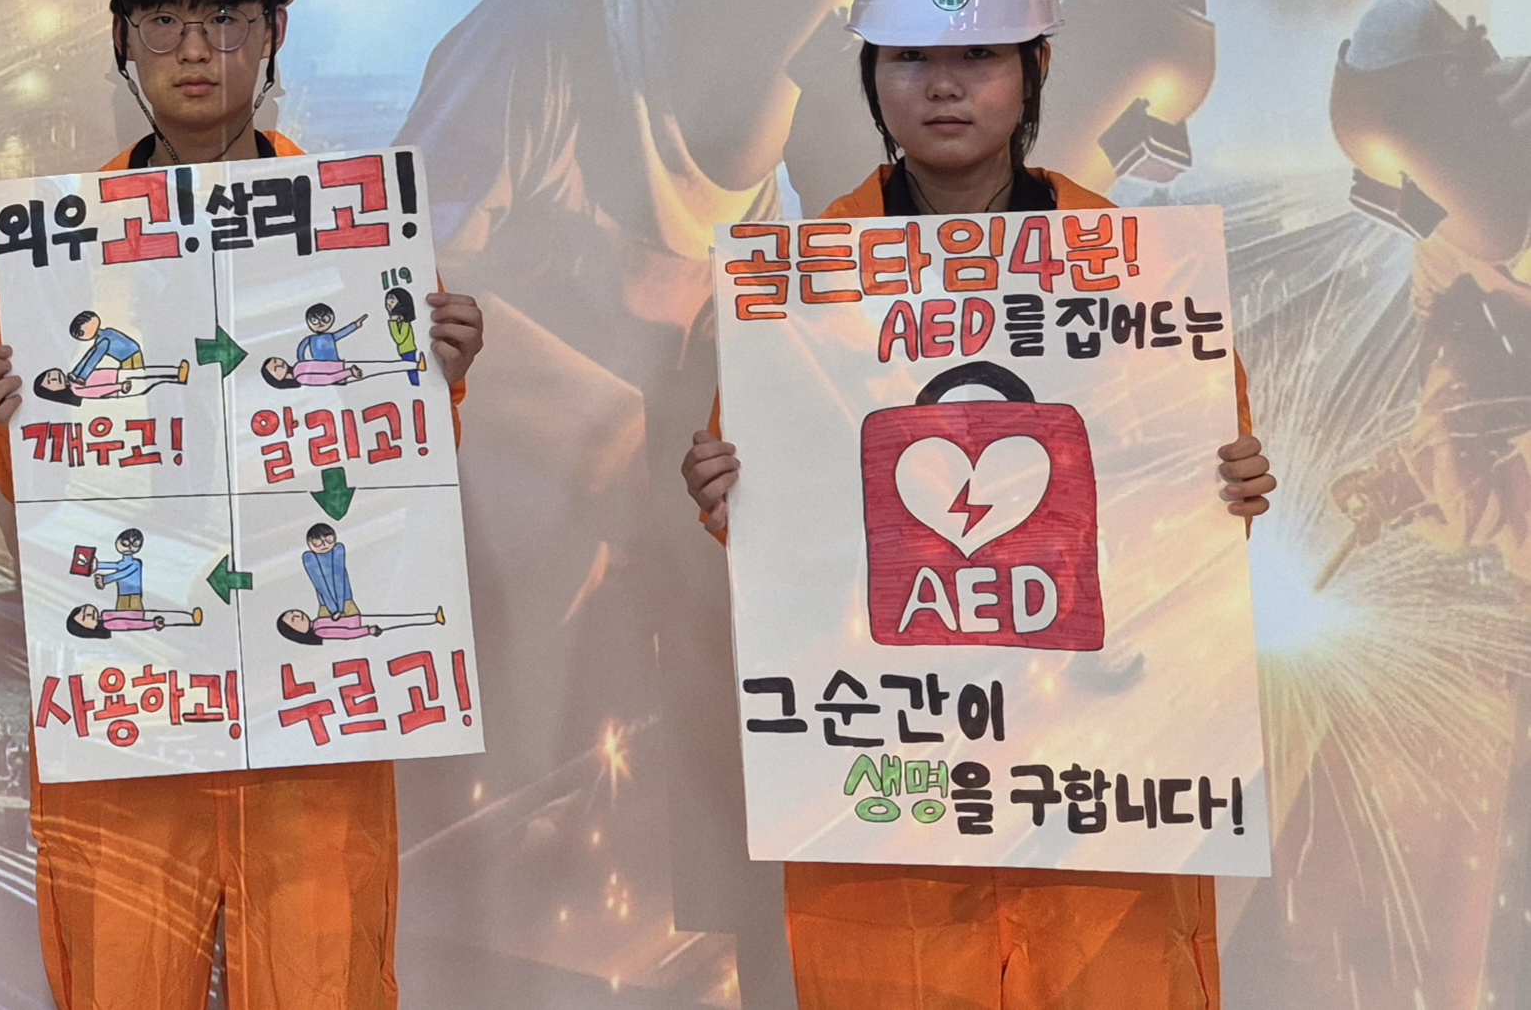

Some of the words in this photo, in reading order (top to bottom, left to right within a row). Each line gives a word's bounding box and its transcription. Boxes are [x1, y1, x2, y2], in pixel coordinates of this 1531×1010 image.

[206, 150, 418, 256] 살리고!
[381, 266, 412, 291] 119
[21, 416, 184, 468] 깨우고!
[250, 399, 429, 484] 알리고!
[896, 564, 1060, 634] AED
[35, 664, 243, 748] 사용하고!
[277, 649, 474, 747] 누르고!
[843, 753, 995, 834] 생명을
[1009, 763, 1246, 836] 구합니다!
